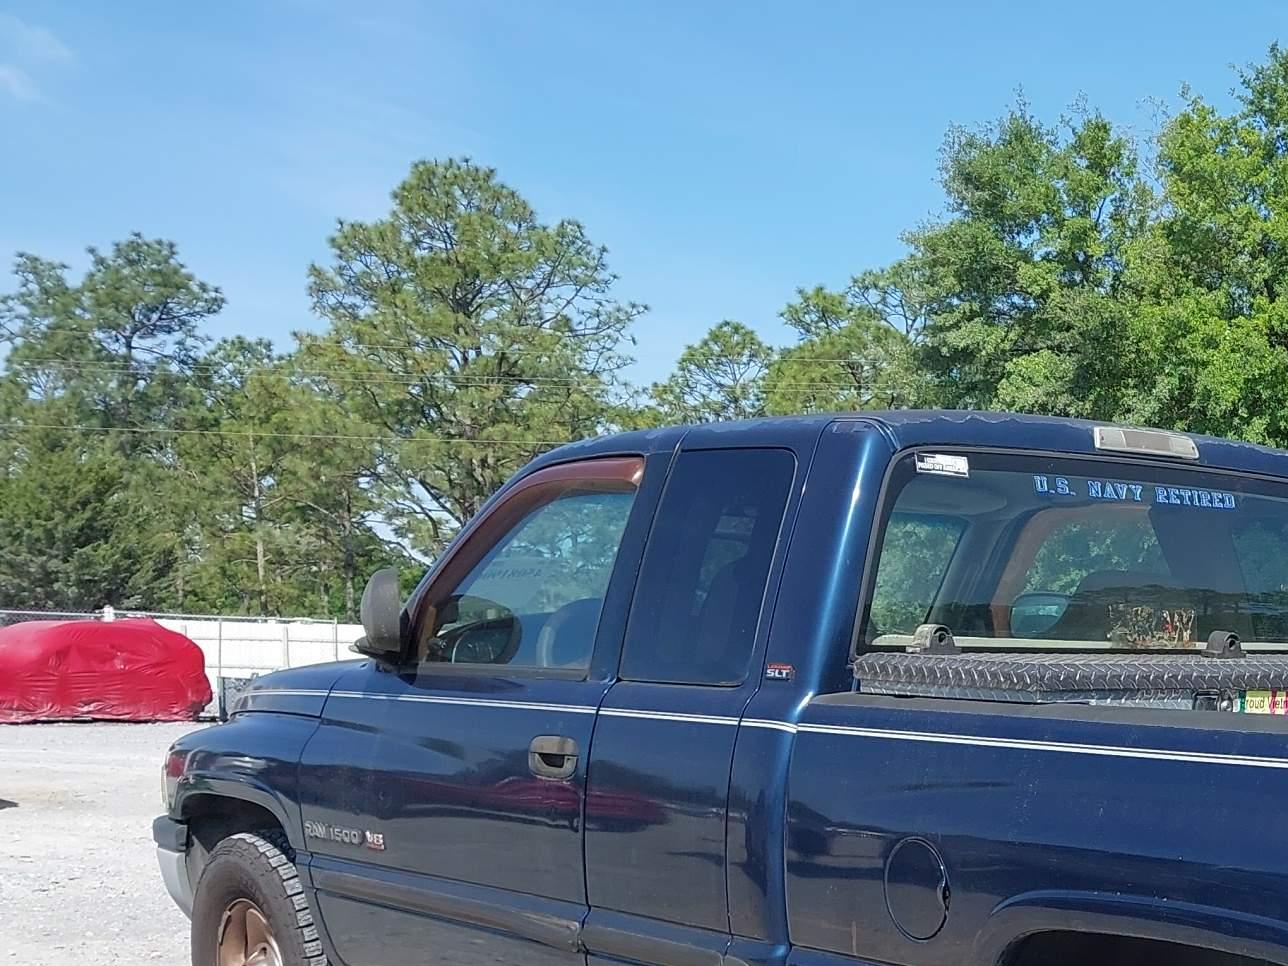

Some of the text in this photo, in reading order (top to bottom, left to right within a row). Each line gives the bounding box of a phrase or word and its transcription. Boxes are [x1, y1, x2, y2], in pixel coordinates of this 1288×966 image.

[1033, 475, 1236, 509] U.S. NAVY RETIRED
[766, 668, 790, 678] SLT
[304, 821, 328, 839] RAM
[329, 825, 361, 845] 1500
